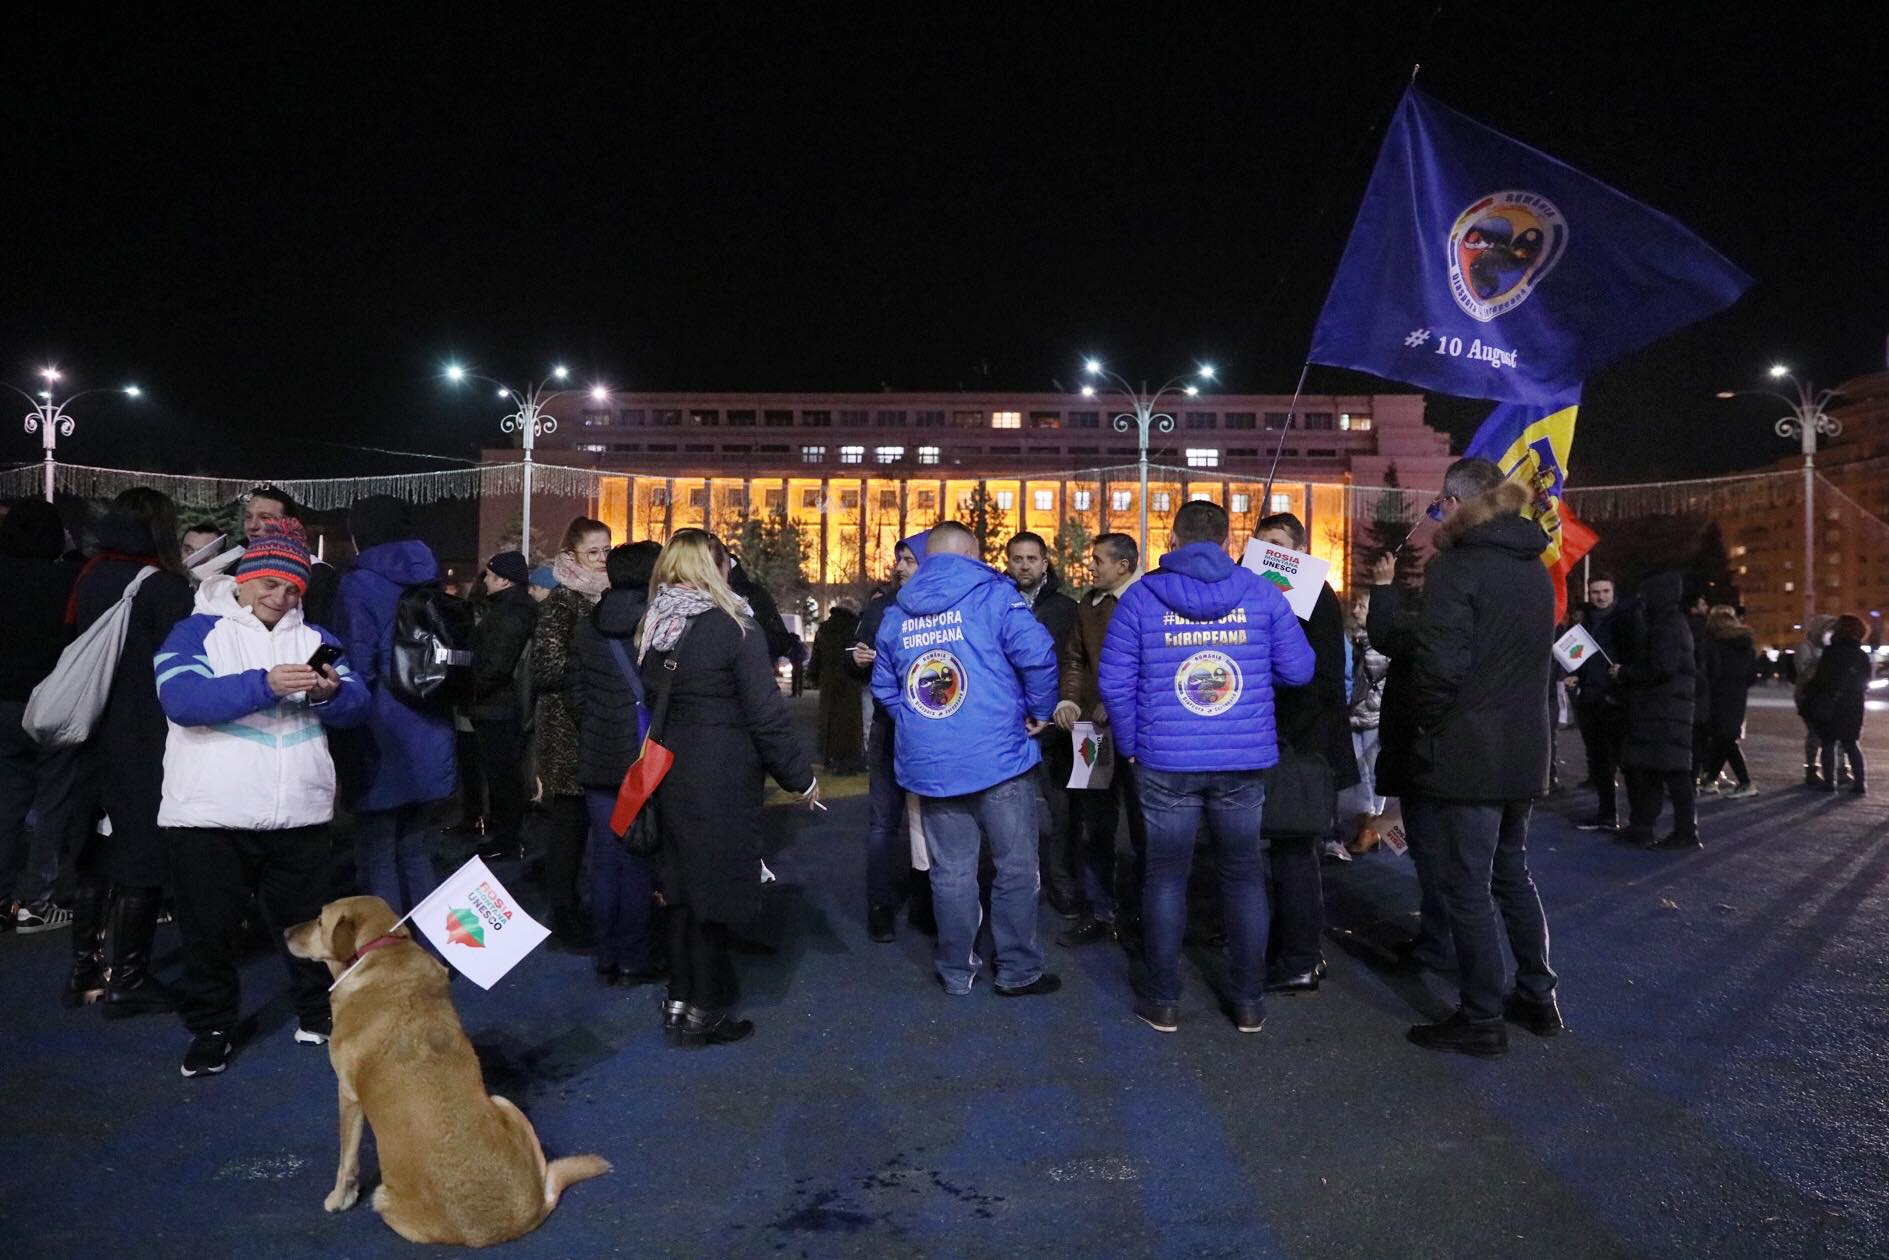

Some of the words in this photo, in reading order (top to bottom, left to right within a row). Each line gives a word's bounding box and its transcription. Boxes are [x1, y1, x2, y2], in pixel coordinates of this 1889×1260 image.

[1435, 336, 1463, 357] 10
[1467, 338, 1518, 369] August
[1262, 559, 1298, 575] UNESCO
[1265, 548, 1301, 565] ROSIA
[901, 610, 963, 634] #DIASPORA
[1163, 608, 1248, 626] #DORA
[902, 627, 965, 650] EUROPEANA
[467, 892, 503, 931] UNESCO
[474, 886, 508, 926] MONTANA
[480, 880, 513, 921] ROSIA
